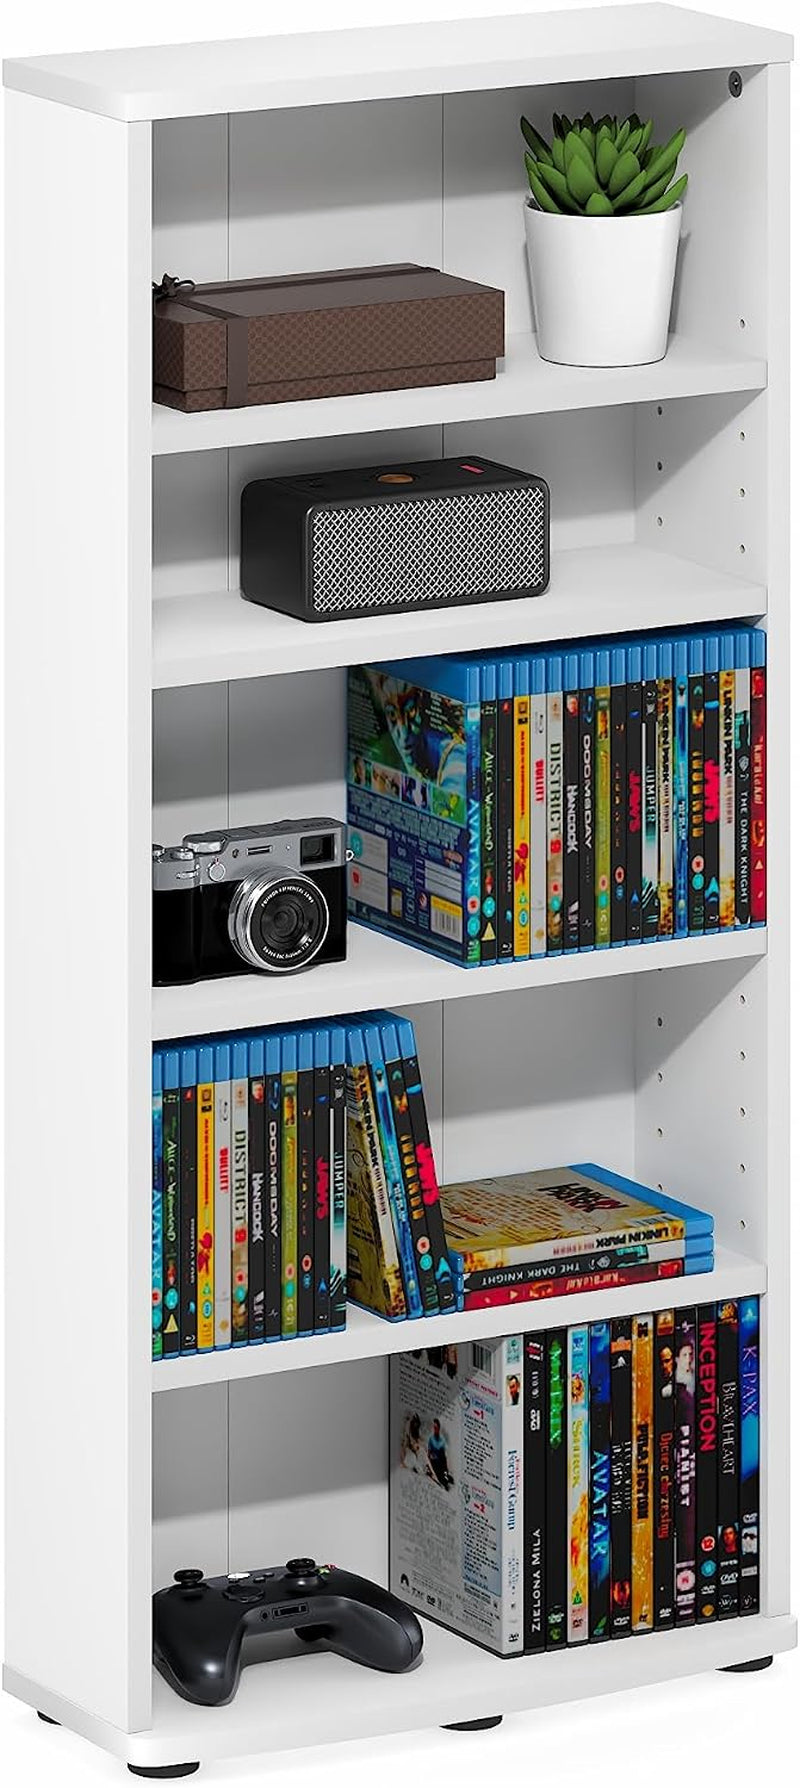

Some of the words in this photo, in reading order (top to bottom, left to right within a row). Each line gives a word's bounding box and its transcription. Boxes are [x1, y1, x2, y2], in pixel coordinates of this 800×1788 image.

[661, 697, 670, 746] LINKIN
[722, 690, 733, 737] LINKIN
[535, 759, 545, 803] BULLITT
[661, 747, 670, 783] PARK
[722, 739, 733, 775] PARK
[550, 743, 562, 833] DISTRICT
[583, 734, 592, 850] DOOMSDAY
[629, 769, 642, 834] JAWS
[646, 765, 656, 824] JUMPER
[740, 791, 748, 812] THE
[468, 799, 479, 887] AVATAR
[551, 838, 562, 855] 9
[567, 784, 578, 855] HANCOCK
[740, 818, 748, 853] DARK
[740, 856, 748, 905] KNIGHT
[219, 1146, 229, 1193] BULLITT
[235, 1130, 247, 1223] DISTRICT
[269, 1121, 279, 1237] DOOMSDAY
[316, 1156, 329, 1220] JAWS
[334, 1151, 345, 1209] JUMPER
[152, 1190, 162, 1278] AVATAR
[235, 1226, 247, 1243] 9
[252, 1172, 265, 1243] HANCOCK
[628, 1226, 669, 1243] LINKIN
[559, 1263, 580, 1274] THE
[596, 1234, 626, 1248] PARK
[481, 1272, 524, 1287] KNIGHT
[528, 1267, 557, 1279] DARK
[699, 1321, 717, 1453] INCEPTION
[743, 1345, 758, 1416] K-PAX
[660, 1432, 673, 1472] Ojciec
[722, 1380, 736, 1476] BRAVEHEART
[636, 1463, 649, 1519] FICTION
[680, 1425, 690, 1506] PIANIST
[591, 1451, 608, 1560] AVATAR
[531, 1528, 541, 1566] MILA
[531, 1570, 541, 1633] ZIELONA
